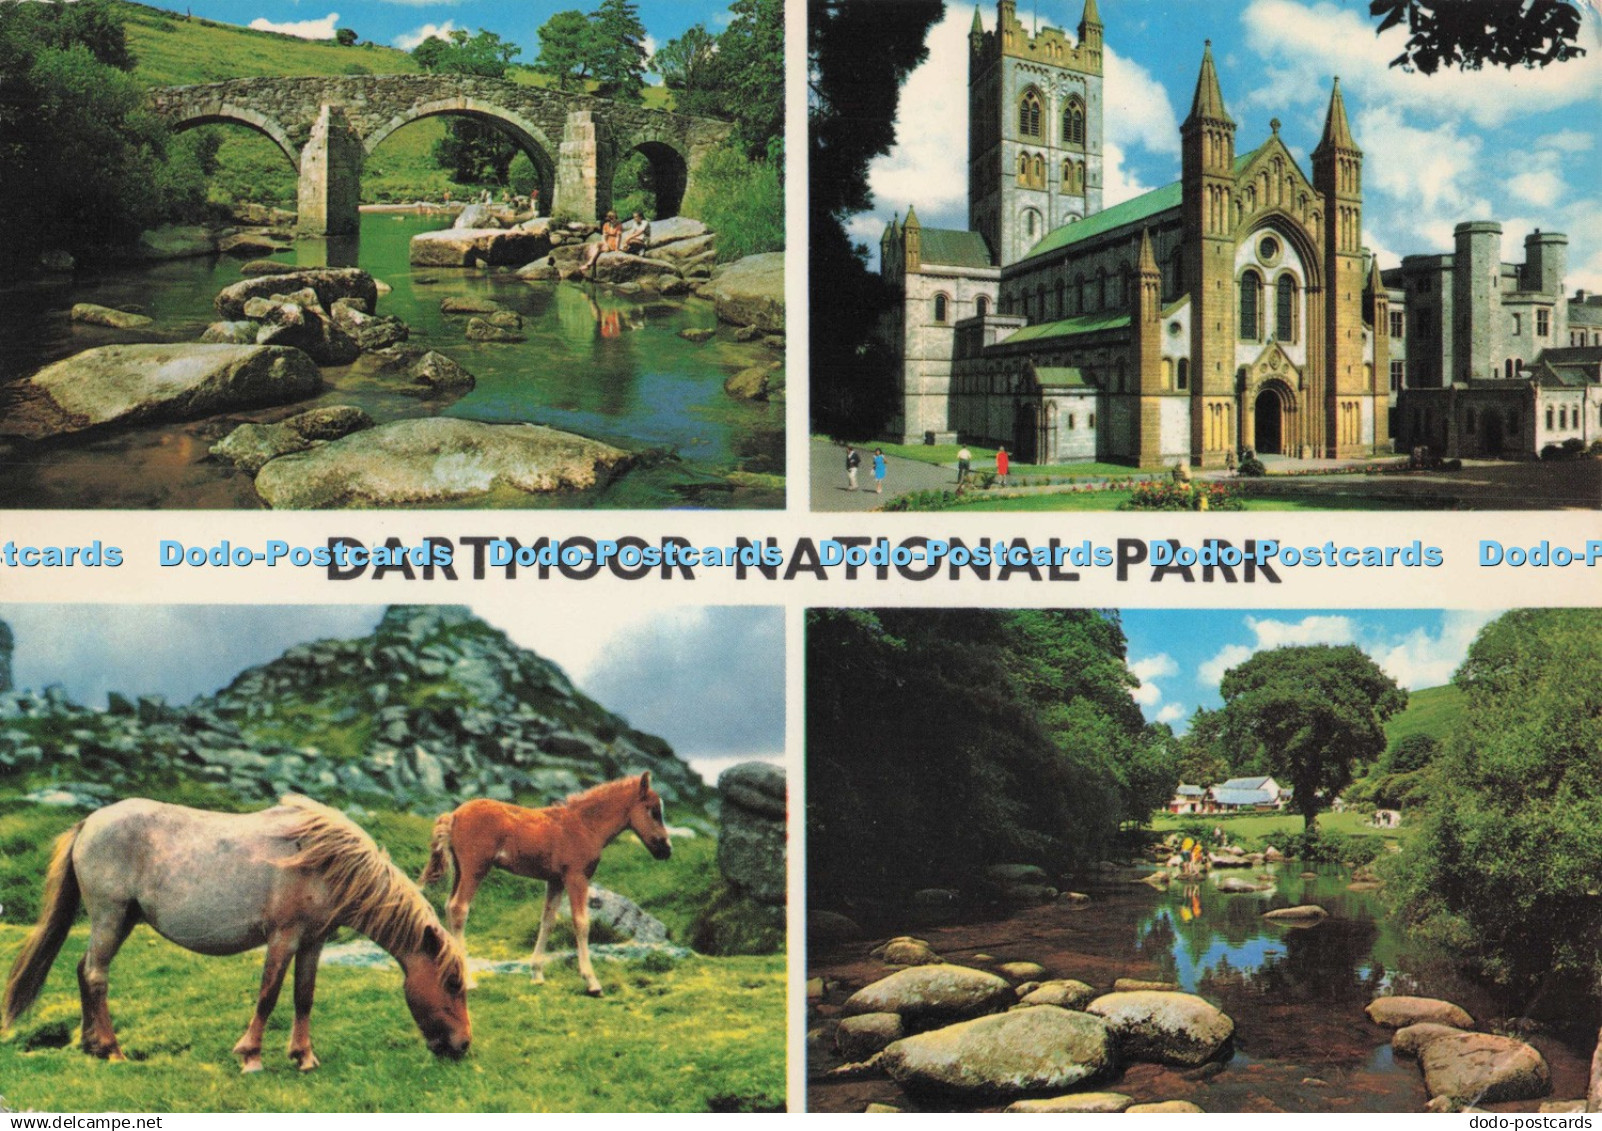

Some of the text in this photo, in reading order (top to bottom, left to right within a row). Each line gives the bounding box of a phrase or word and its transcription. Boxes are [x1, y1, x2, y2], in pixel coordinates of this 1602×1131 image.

[326, 536, 1282, 584] DARTMOOR NATIONAL PARK
